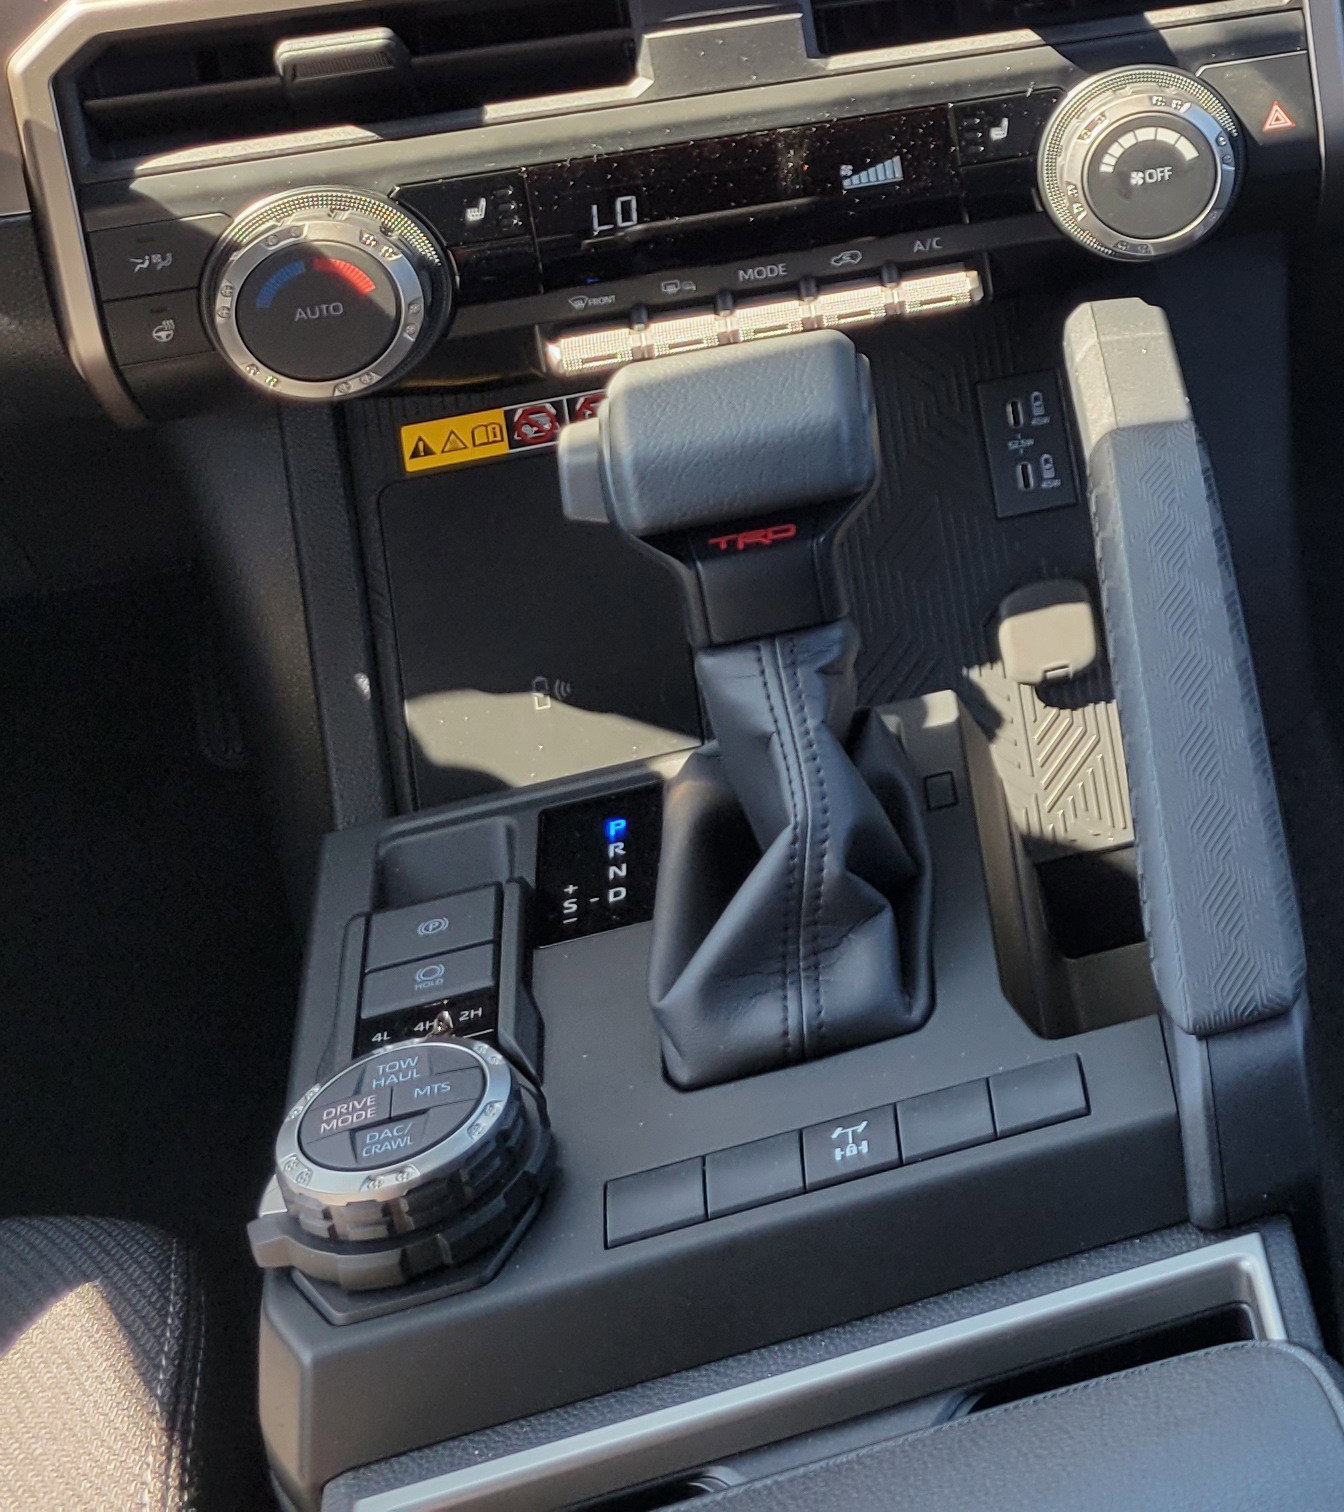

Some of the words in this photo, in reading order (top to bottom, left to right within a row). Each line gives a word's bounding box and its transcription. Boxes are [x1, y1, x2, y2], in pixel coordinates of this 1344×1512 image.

[1145, 166, 1173, 184] OFF
[592, 195, 637, 232] LO
[913, 236, 944, 253] A/C
[738, 263, 788, 282] MODE
[588, 294, 616, 306] FRONT
[293, 301, 344, 322] AUTO
[708, 523, 797, 550] TRD
[609, 818, 627, 838] P
[608, 841, 627, 859] R
[609, 863, 627, 881] N
[608, 887, 627, 904] D
[563, 899, 578, 914] S
[414, 978, 444, 991] HOLD
[371, 1031, 391, 1043] 4L
[413, 1018, 438, 1032] 4H
[459, 1007, 483, 1022] 2H
[377, 1055, 419, 1075] TOW
[372, 1068, 421, 1089] HAUL
[414, 1081, 451, 1099] MTS
[323, 1094, 377, 1121] DRIVE
[320, 1106, 377, 1134] MODE
[366, 1121, 414, 1145] DAC/
[362, 1135, 414, 1158] CRAWL
